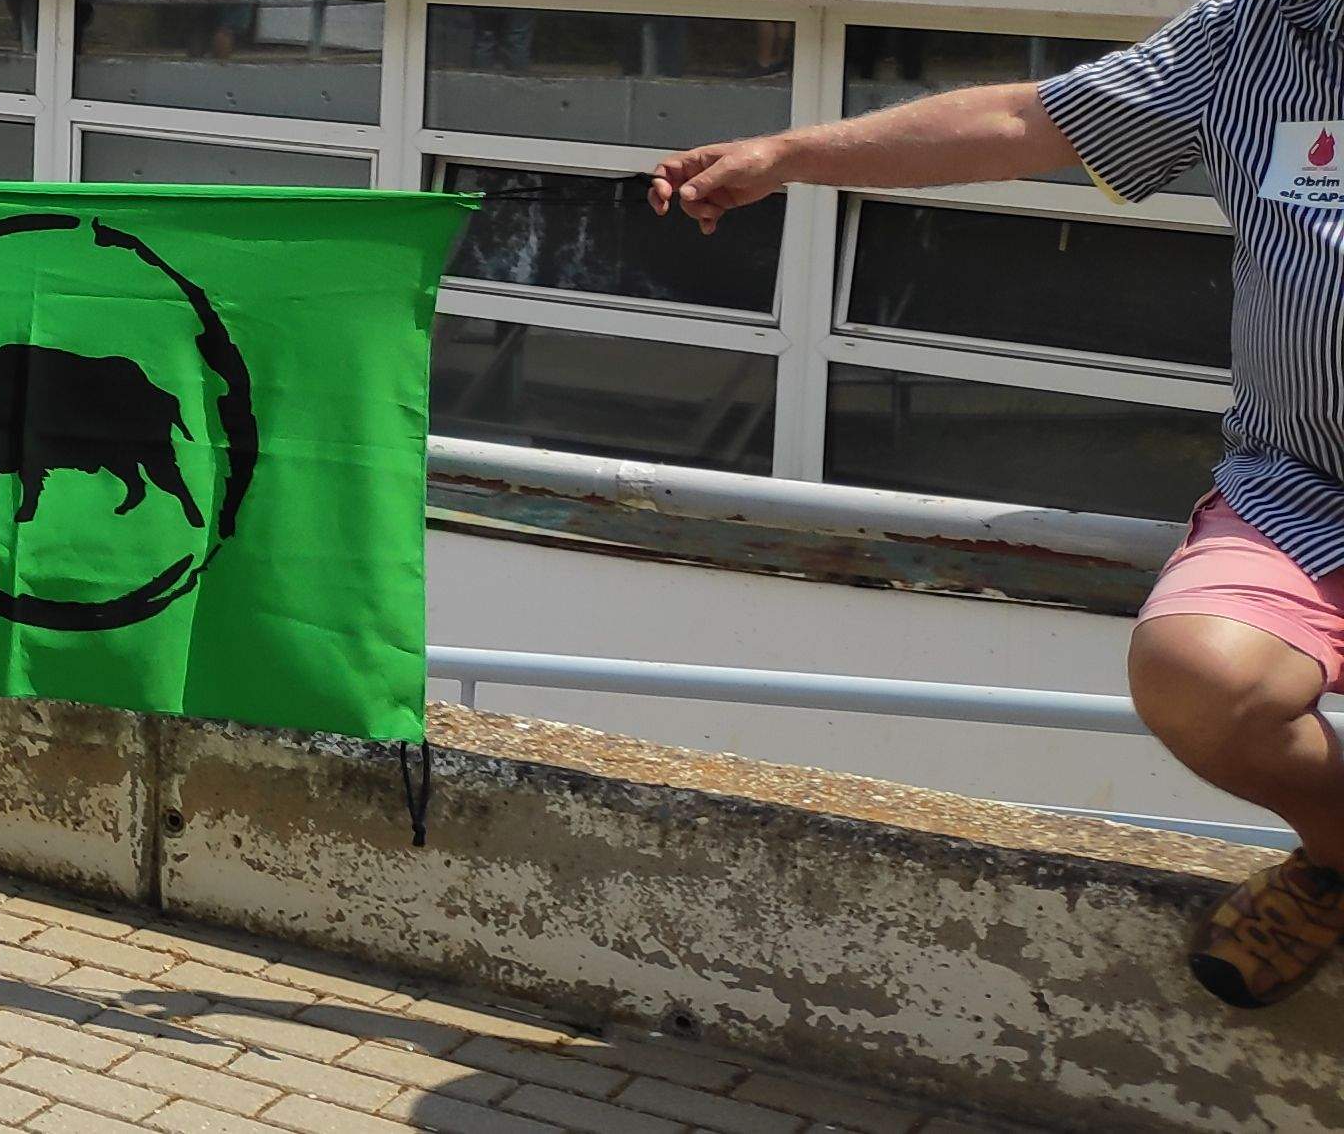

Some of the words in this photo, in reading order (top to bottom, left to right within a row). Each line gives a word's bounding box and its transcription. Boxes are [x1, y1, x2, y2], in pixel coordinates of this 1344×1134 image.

[1293, 176, 1340, 187] Obrim
[1279, 189, 1303, 200] els
[1307, 192, 1344, 202] CAPs
